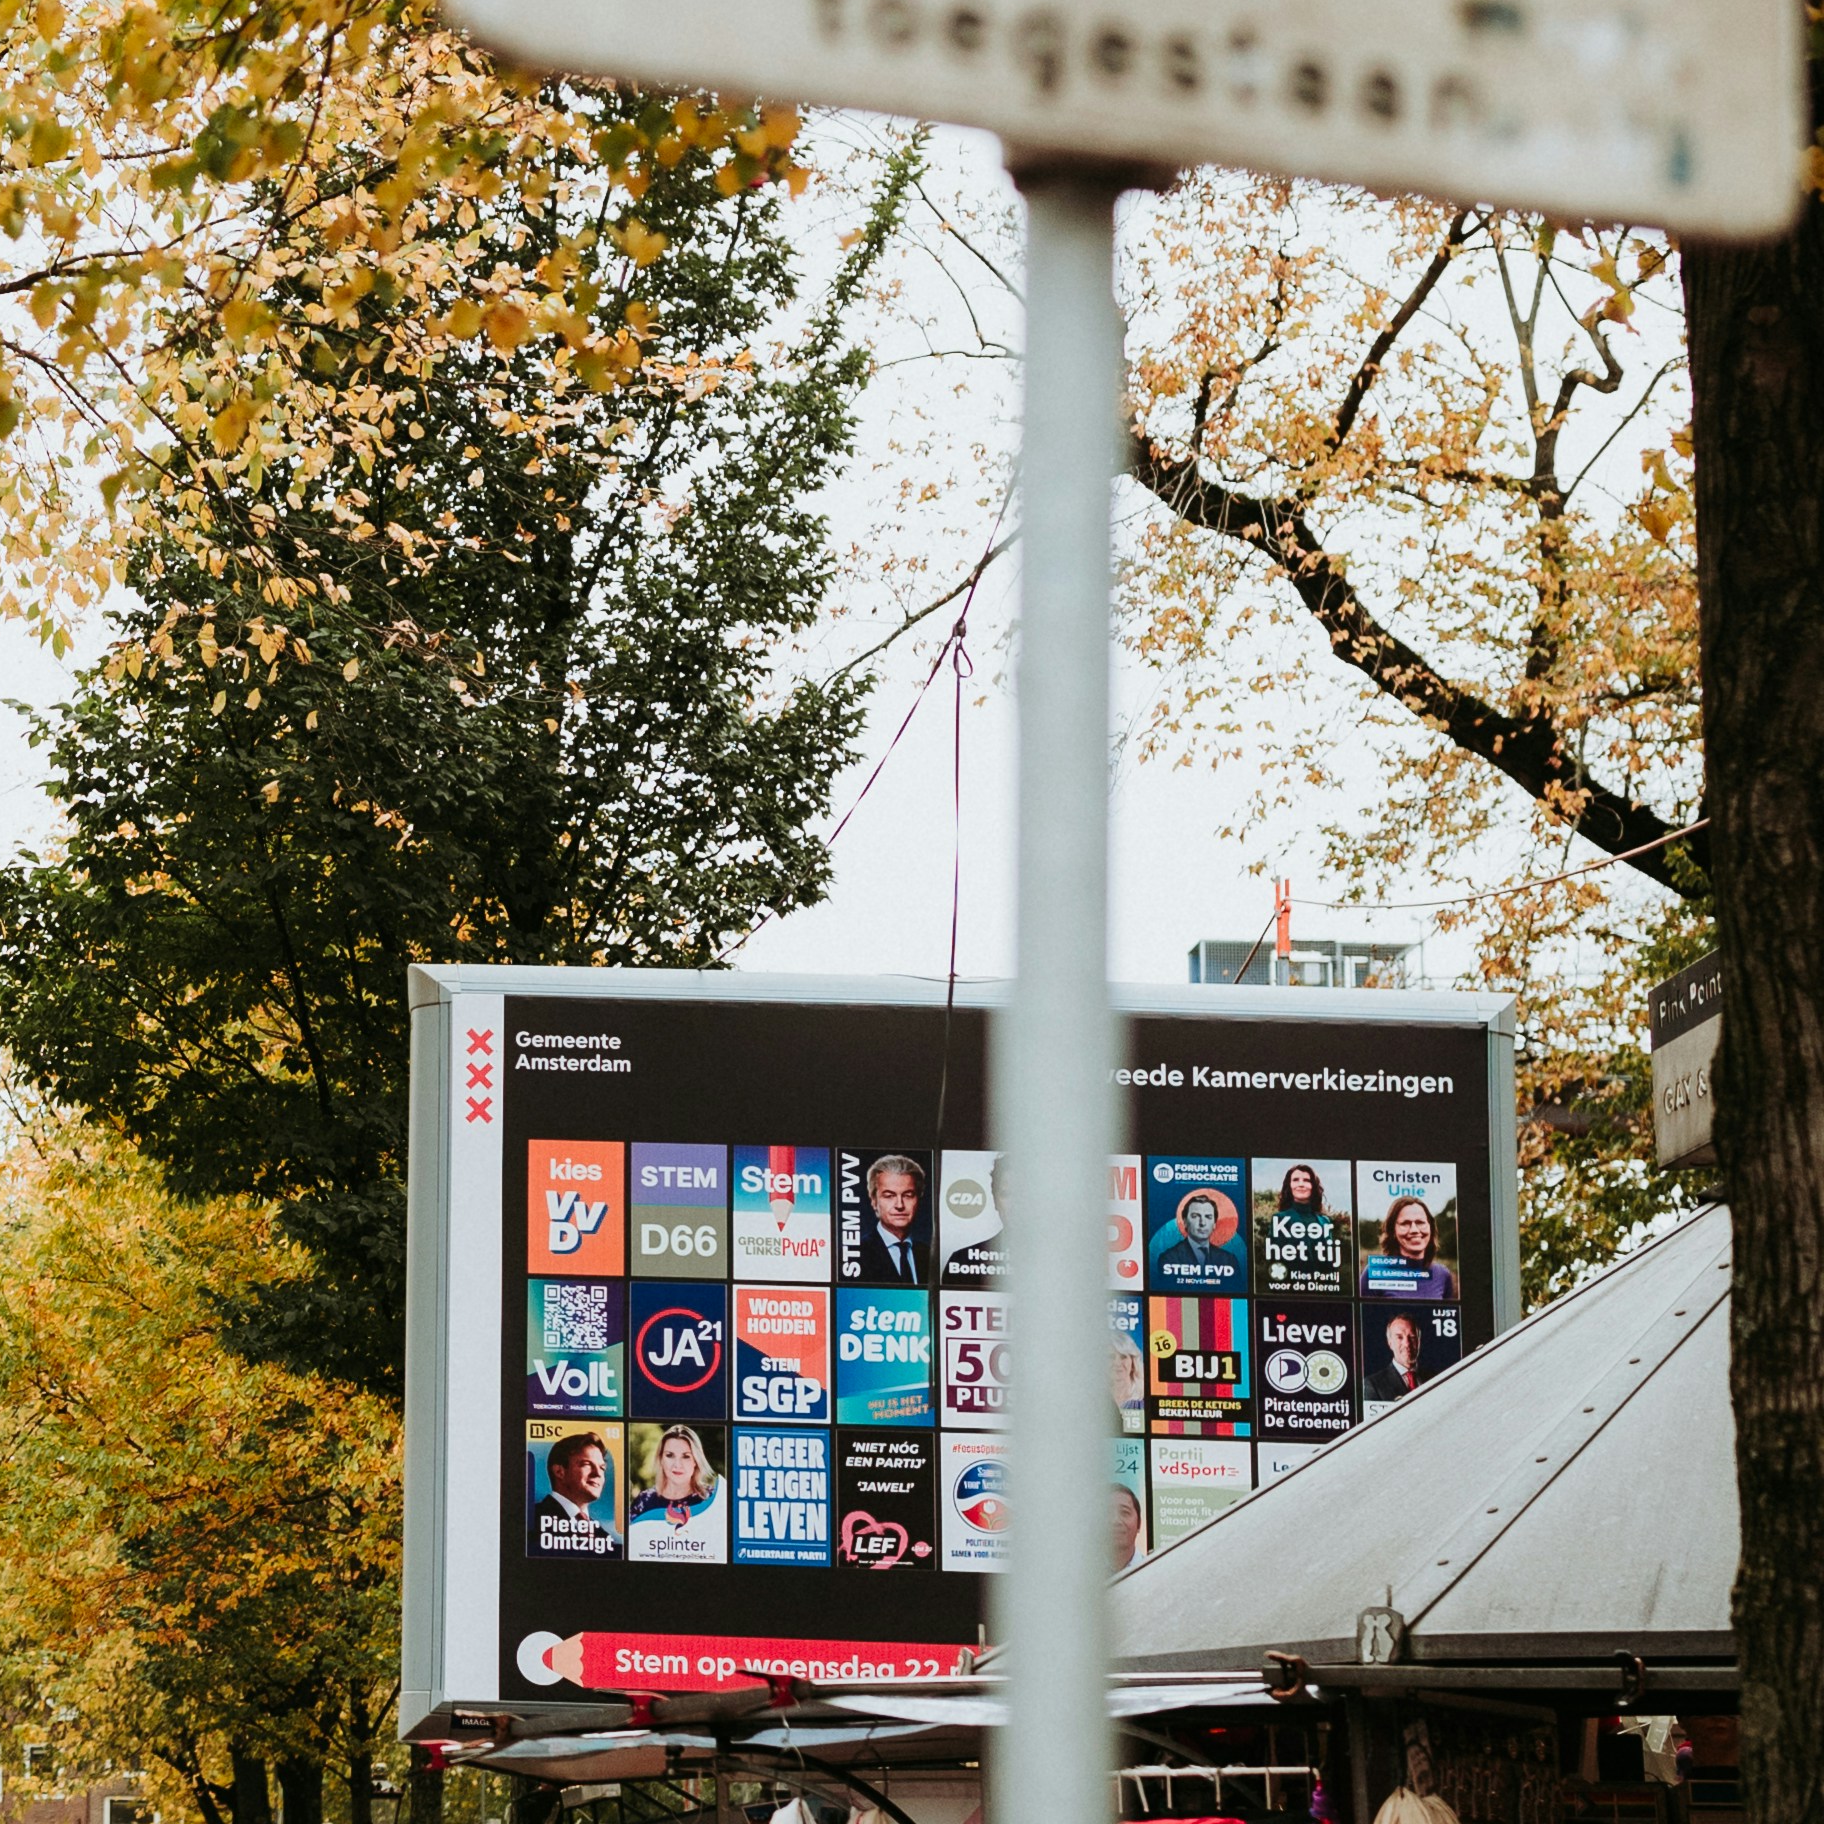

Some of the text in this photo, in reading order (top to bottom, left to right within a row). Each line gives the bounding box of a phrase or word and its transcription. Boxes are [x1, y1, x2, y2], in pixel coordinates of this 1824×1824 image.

[1659, 972, 1722, 1027] Pink Point
[516, 1031, 621, 1049] Gemeente
[515, 1054, 631, 1072] Amsterdam
[1192, 1066, 1453, 1098] Kamerverkiezingen
[1664, 1075, 1692, 1115] GAY
[550, 1158, 602, 1181] kies
[641, 1166, 717, 1188] STEM
[1175, 1164, 1238, 1173] FORUM VOOR
[1175, 1172, 1238, 1182] DEMOCRATIE
[1373, 1170, 1441, 1183] Christen
[741, 1165, 821, 1194] Stem
[949, 1192, 983, 1205] CDA
[1388, 1184, 1425, 1197] Unie
[841, 1153, 861, 1277] STEM PVV
[1273, 1216, 1334, 1239] Keer
[641, 1223, 717, 1257] D66
[738, 1236, 781, 1246] GROEN
[782, 1237, 819, 1257] PvdA
[746, 1246, 782, 1256] LINKS
[968, 1248, 1010, 1261] Henri
[1266, 1238, 1341, 1267] het tij
[1163, 1263, 1234, 1276] STEM FVD
[1291, 1271, 1340, 1282] Kies Partij
[1293, 1282, 1305, 1291] de
[1308, 1282, 1340, 1291] Dieren
[748, 1298, 813, 1317] WOORD
[1433, 1309, 1456, 1317] LIJST
[747, 1317, 816, 1335] HOUDEN
[850, 1306, 921, 1333] stem
[945, 1305, 1012, 1332] STE
[1108, 1316, 1139, 1331] ter
[1263, 1314, 1346, 1344] Liever
[1432, 1319, 1457, 1337] 18
[648, 1321, 722, 1366] JA21
[840, 1333, 930, 1363] DENK
[1155, 1339, 1171, 1352] 16
[761, 1357, 800, 1372] STEM
[1176, 1354, 1236, 1379] BIJ1
[533, 1359, 617, 1397] Volt
[742, 1376, 821, 1414] SGP
[1159, 1399, 1241, 1410] BREEK DE KETENS
[1159, 1408, 1222, 1418] BEKEN KLEUR
[1265, 1397, 1349, 1416] Piratenpartij
[1125, 1417, 1140, 1429] 15
[1265, 1415, 1350, 1429] De Groenen
[530, 1423, 563, 1439] nsc
[737, 1436, 825, 1469] REGEER
[889, 1441, 919, 1454] NÓG
[1116, 1444, 1139, 1456] Lijst
[1159, 1447, 1203, 1463] Partij
[846, 1457, 872, 1467] EEN
[1115, 1459, 1139, 1474] 24
[1160, 1462, 1225, 1478] vdSport
[737, 1469, 826, 1500] JE EIGEN
[1160, 1496, 1183, 1505] Voor
[738, 1500, 826, 1541] LEVEN
[1160, 1507, 1200, 1517] gezond,
[1201, 1507, 1211, 1515] fit
[540, 1516, 599, 1533] Pieter
[1160, 1517, 1188, 1526] vitaal
[540, 1533, 614, 1554] Omtzigt
[649, 1537, 706, 1554] splinter
[855, 1536, 896, 1554] LEF
[746, 1549, 826, 1560] LIBERTAIRE PARTIJ
[616, 1648, 689, 1676] Stem
[697, 1653, 735, 1681] op
[744, 1649, 895, 1679] woensdag
[905, 1658, 940, 1677] 22
